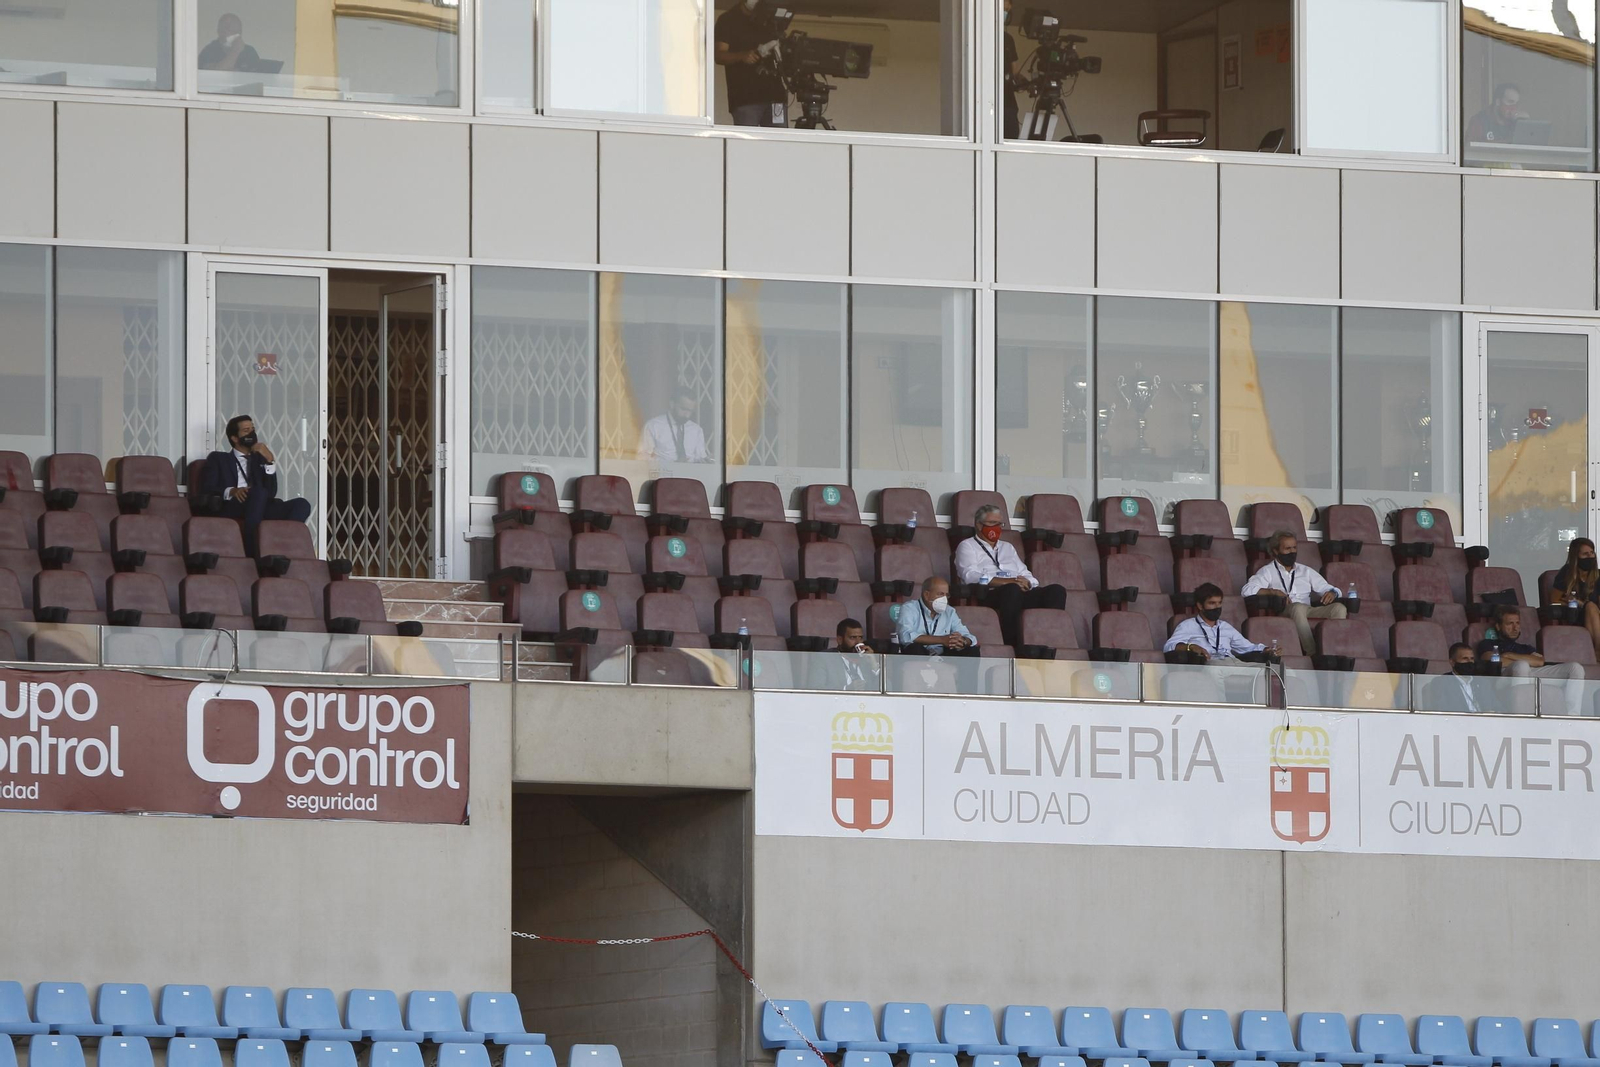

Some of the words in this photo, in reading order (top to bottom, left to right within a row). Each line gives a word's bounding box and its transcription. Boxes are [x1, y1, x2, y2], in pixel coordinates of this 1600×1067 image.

[283, 690, 436, 744] grupo
[0, 725, 124, 778] ntrol
[284, 737, 460, 790] control
[953, 714, 1225, 783] ALMERÍA
[1388, 733, 1595, 793] ALMER
[286, 792, 378, 814] seguridad
[953, 788, 1091, 826] CIUDAD
[1388, 799, 1523, 837] CIUDAD
